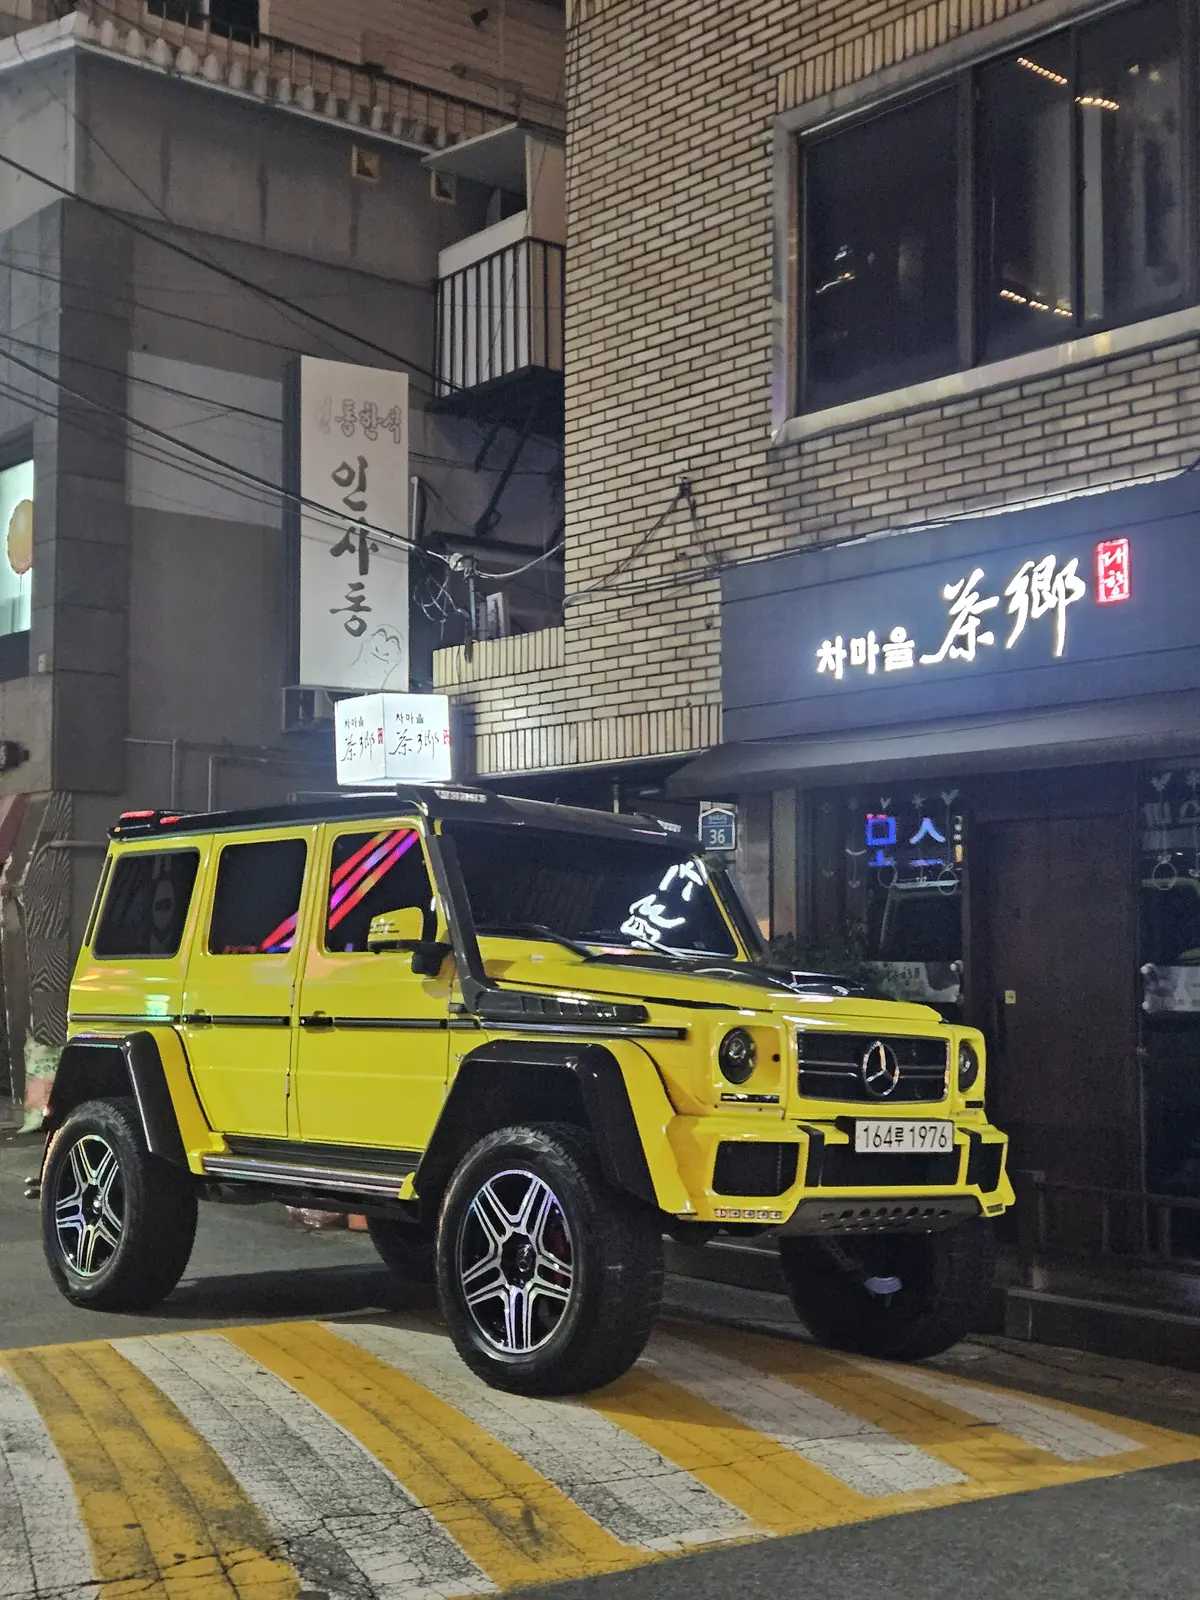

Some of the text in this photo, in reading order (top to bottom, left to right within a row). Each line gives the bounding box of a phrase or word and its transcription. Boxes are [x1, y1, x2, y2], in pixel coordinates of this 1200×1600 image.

[330, 455, 380, 638] 인사동
[815, 625, 915, 680] 차마을
[344, 715, 365, 729] 차마을
[395, 712, 425, 724] 차마을
[709, 828, 726, 845] 36
